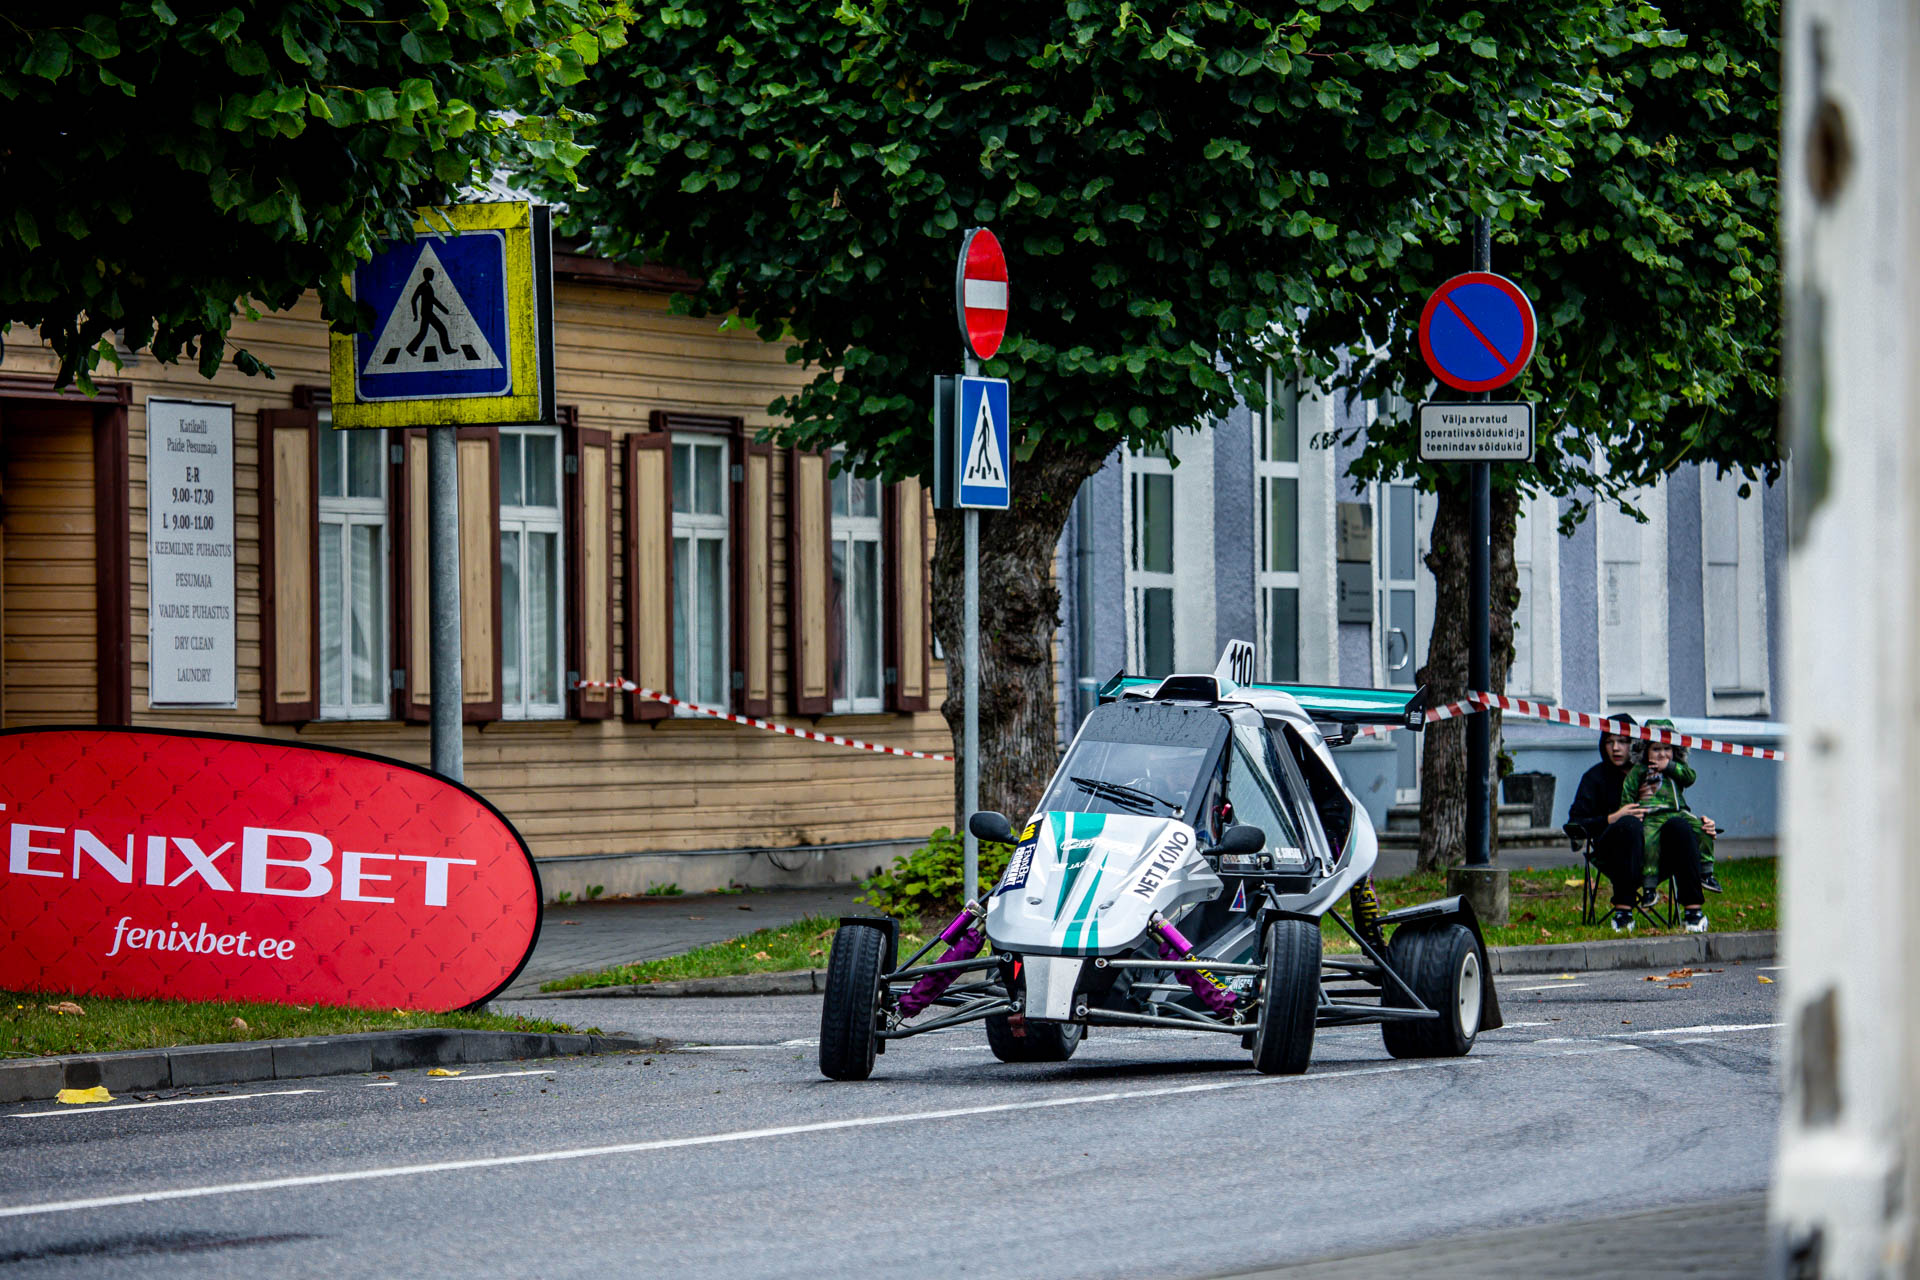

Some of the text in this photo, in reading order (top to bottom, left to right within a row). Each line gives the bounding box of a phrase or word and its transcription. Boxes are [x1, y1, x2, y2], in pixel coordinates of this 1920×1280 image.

[1441, 414, 1508, 425] Välja arvatud
[167, 437, 217, 456] Paide Pesumaja
[1427, 442, 1522, 452] teenindav sõidukid
[163, 513, 168, 529] L
[155, 541, 232, 557] KEEMILINE PUHASTUS
[175, 572, 212, 589] PESUMAJA
[159, 604, 230, 620] VAIPADE PUHASTUS
[174, 635, 214, 651] DRY CLEAN
[1230, 643, 1252, 688] 110
[177, 668, 212, 682] LAUNDRY
[0, 803, 477, 906] ENIXBET
[106, 916, 296, 960] fenixbet.ee
